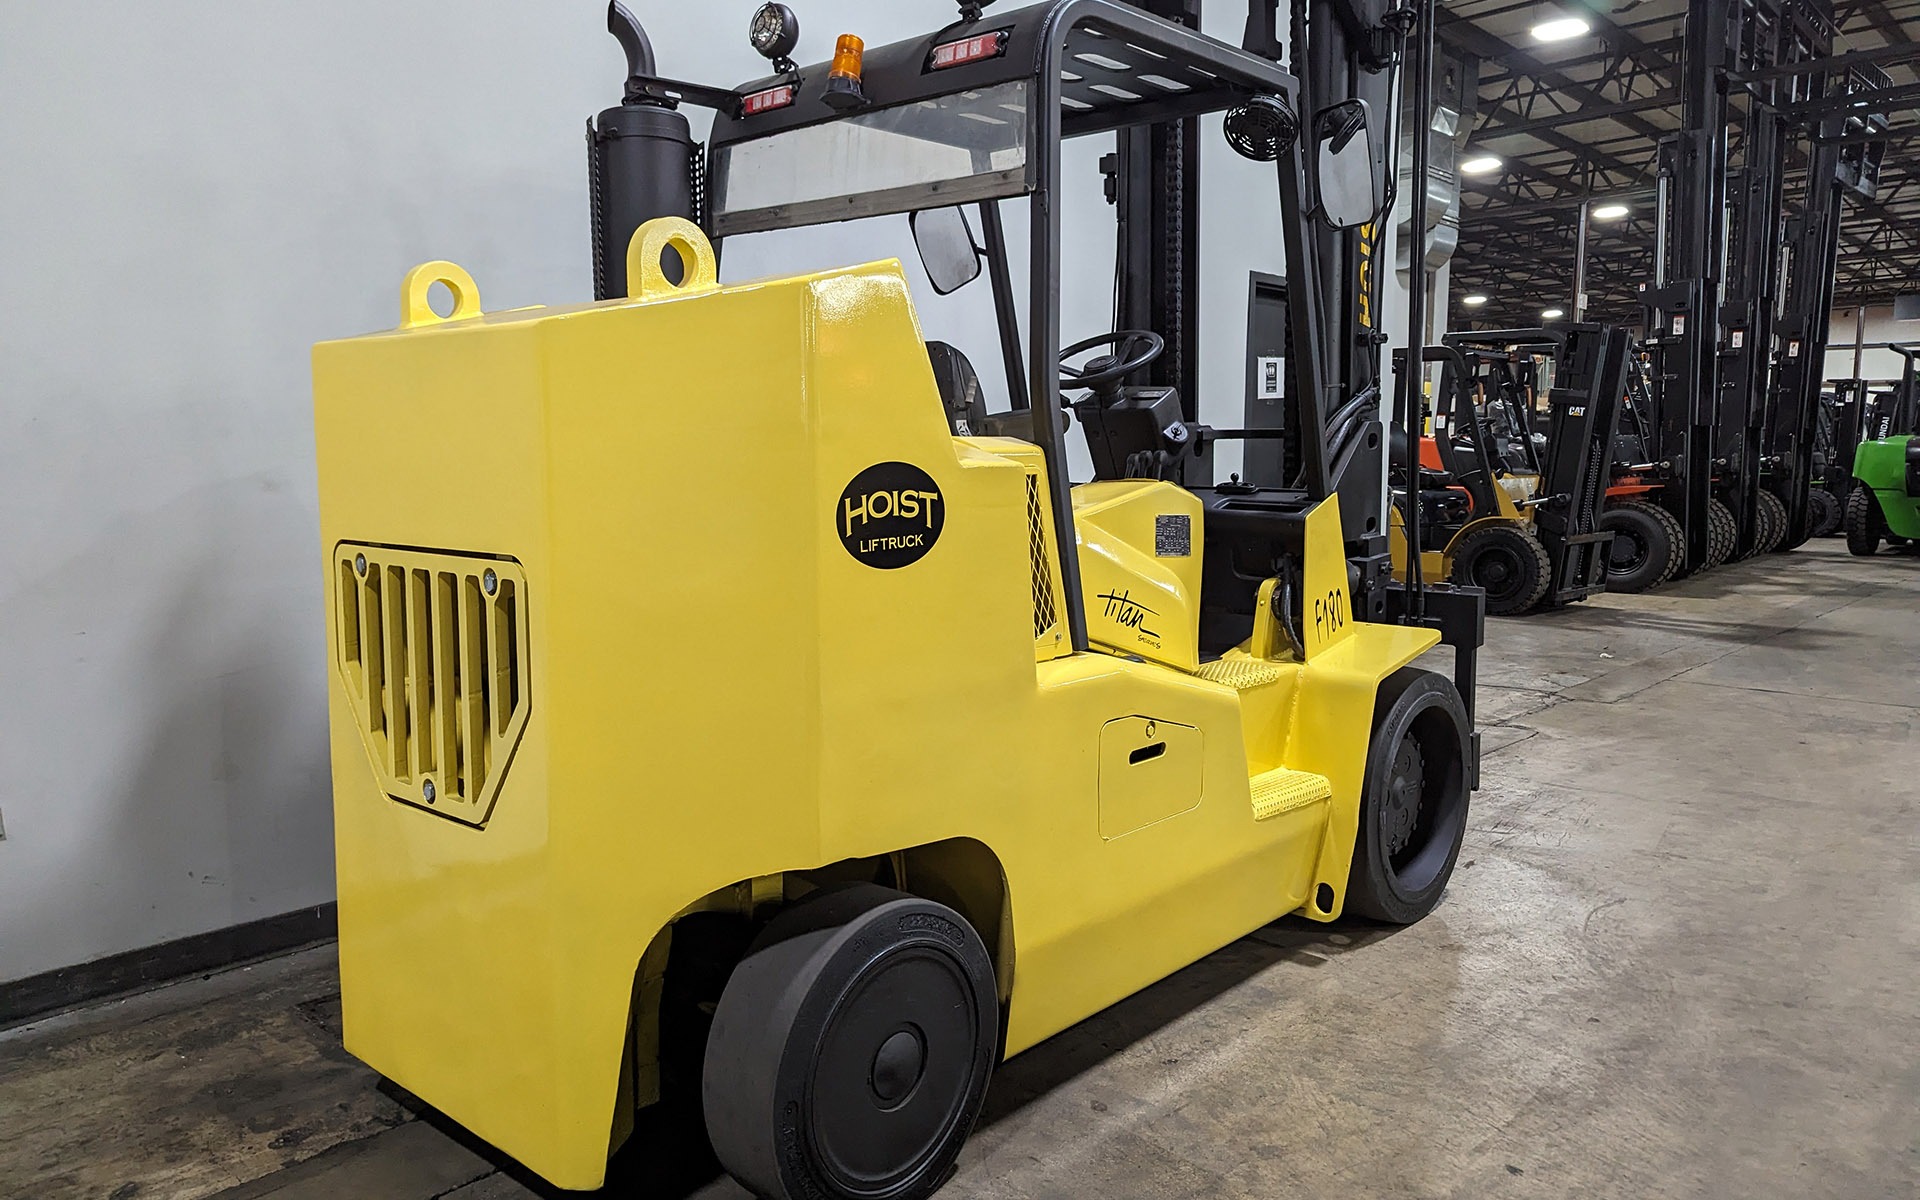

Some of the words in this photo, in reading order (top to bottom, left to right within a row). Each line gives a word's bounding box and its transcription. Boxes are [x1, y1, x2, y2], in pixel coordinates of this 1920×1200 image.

[1359, 221, 1377, 329] HOIS
[1568, 406, 1586, 416] CAT
[1877, 416, 1890, 441] UNDAI
[844, 489, 938, 538] HOIST
[860, 534, 924, 553] LIFTRUCK
[1315, 587, 1343, 644] F180
